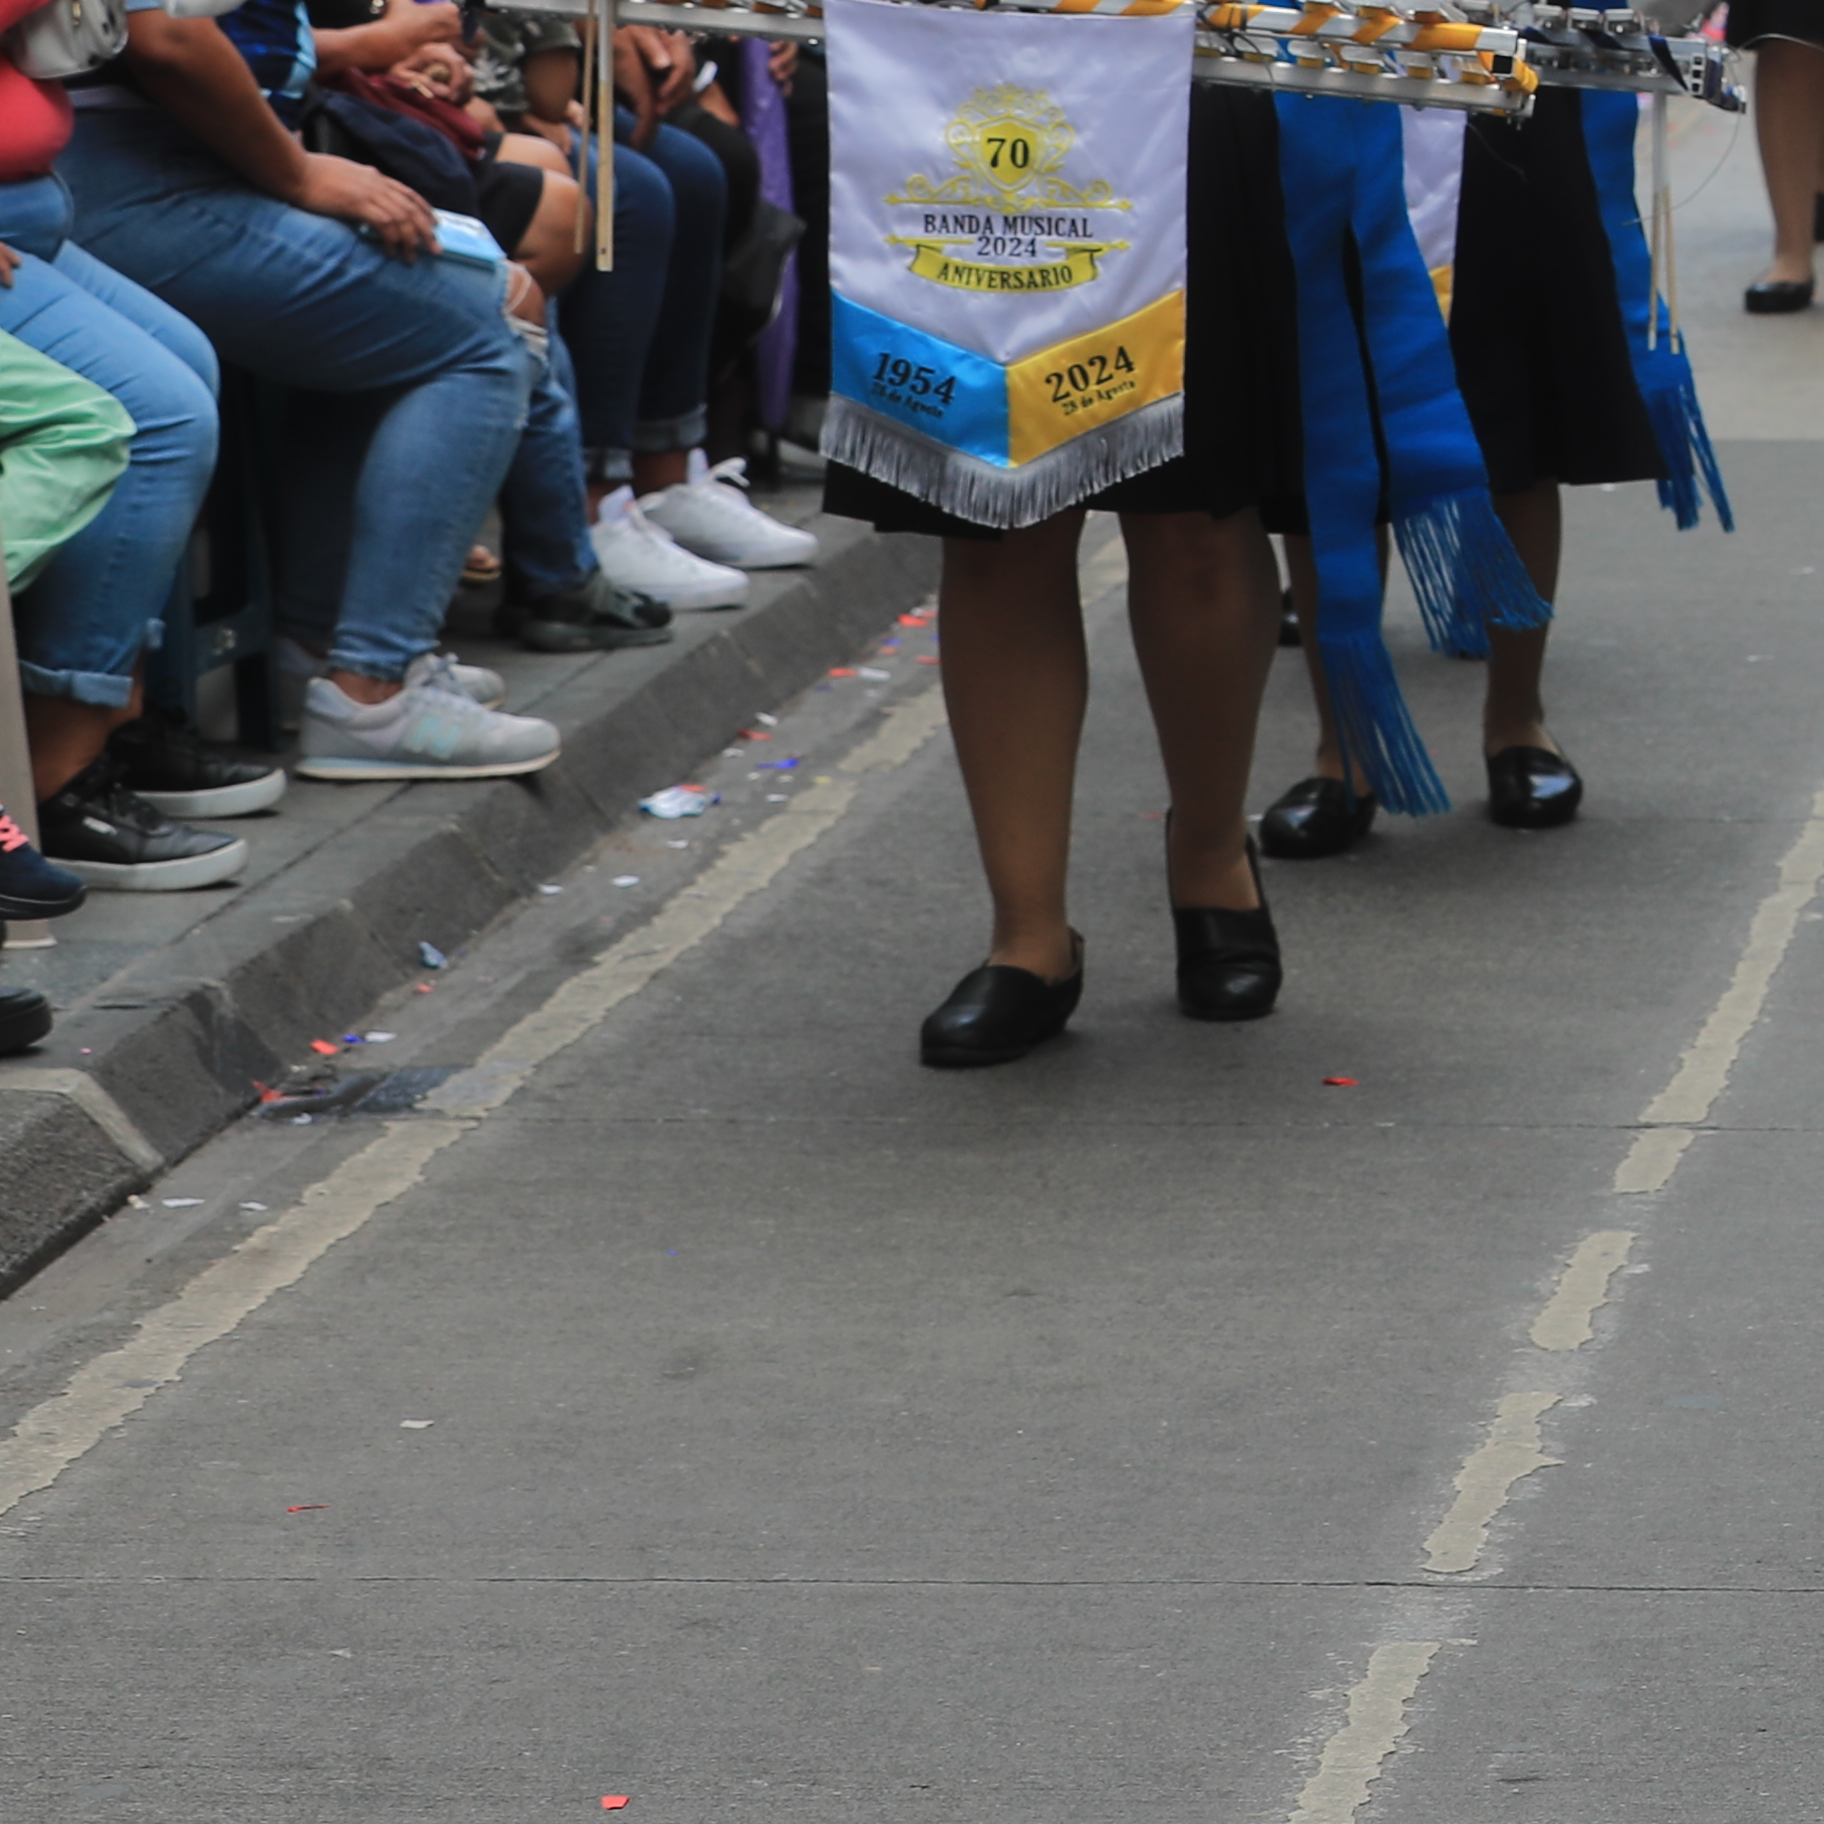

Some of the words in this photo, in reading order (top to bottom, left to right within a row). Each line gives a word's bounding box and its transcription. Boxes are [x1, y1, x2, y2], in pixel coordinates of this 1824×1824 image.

[986, 137, 1031, 170] 70
[923, 213, 995, 235] BANDA
[1002, 215, 1094, 239] MUSICAL
[976, 236, 1038, 257] 2024
[936, 262, 1074, 290] ANIVERSARIO
[873, 351, 959, 407] 1954
[1044, 344, 1136, 404] 2024
